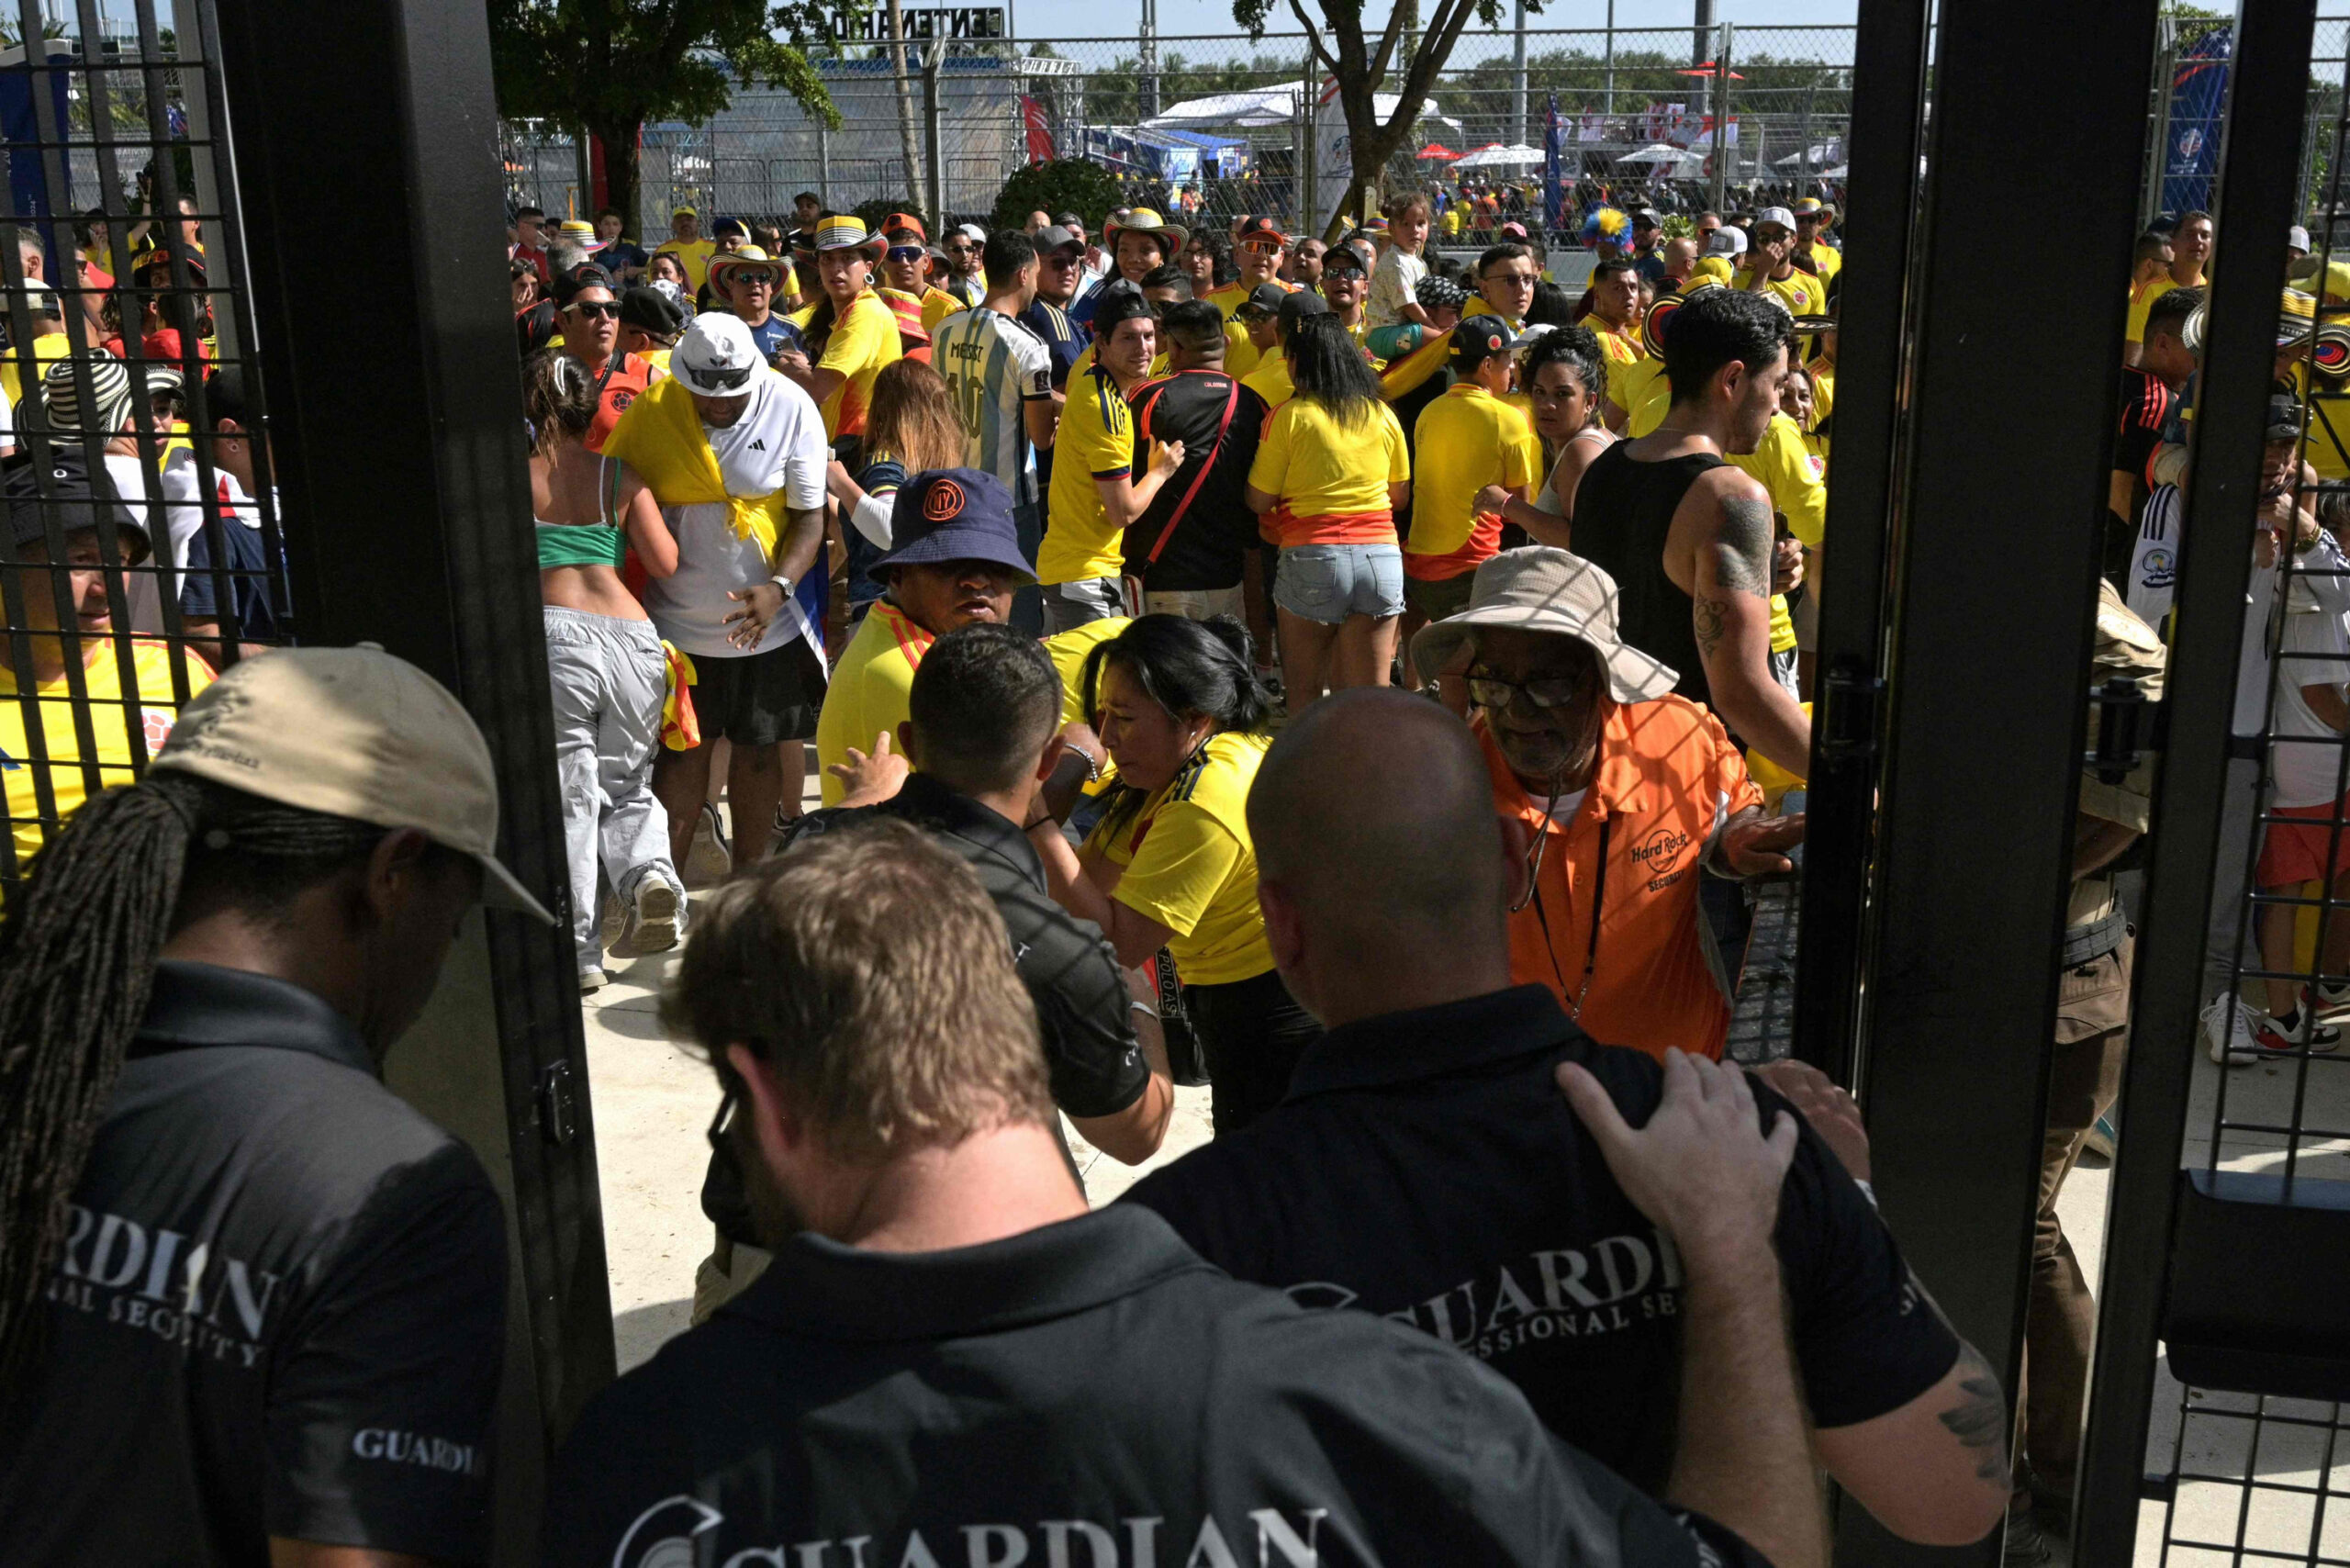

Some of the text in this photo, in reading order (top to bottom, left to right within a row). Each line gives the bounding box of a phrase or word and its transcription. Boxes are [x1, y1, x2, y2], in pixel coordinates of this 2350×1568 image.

[950, 342, 984, 364] MESSI
[1630, 839, 1662, 864] Hard
[1664, 830, 1688, 854] Rock
[1158, 954, 1175, 990] POLO
[63, 1204, 279, 1340] RDIAN
[1384, 1227, 1682, 1347] UARDI
[1477, 1305, 1630, 1359] SSIONAL
[352, 1428, 475, 1475] GUARDI
